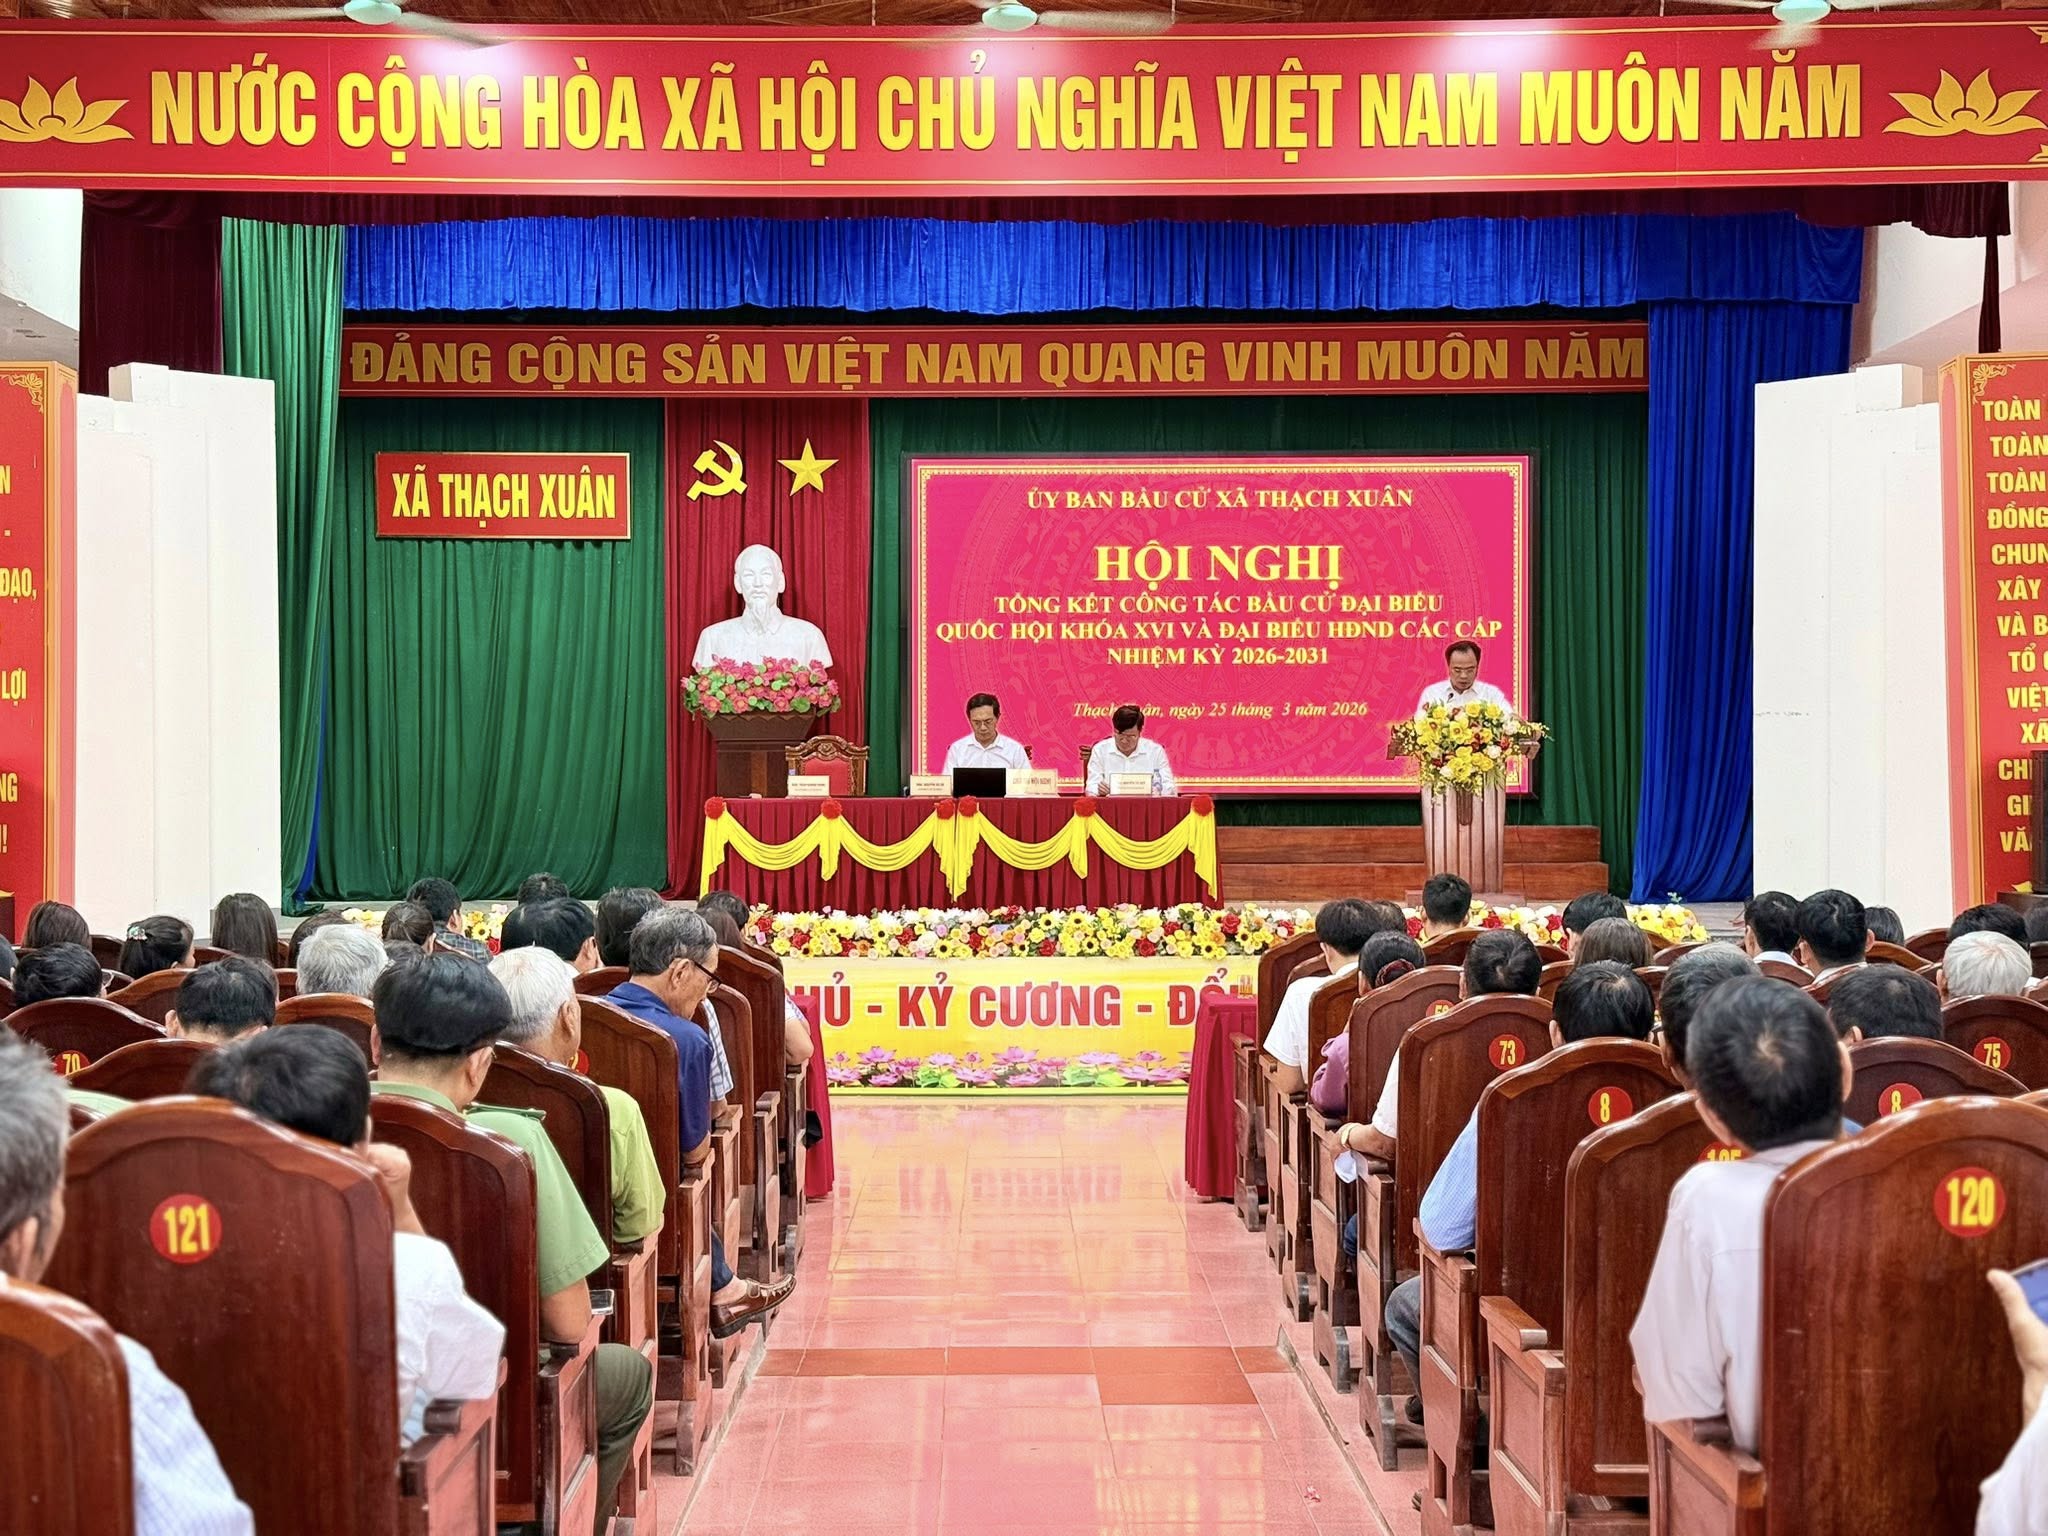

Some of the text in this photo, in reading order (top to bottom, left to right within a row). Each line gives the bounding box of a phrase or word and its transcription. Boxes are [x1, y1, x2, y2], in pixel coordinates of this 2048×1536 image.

[152, 48, 1861, 166] NƯỚC CỘNG HÒA XÃ HỘI CHỦ NGHĨA VIỆT NAM MUÔN NĂM
[350, 331, 1644, 390] ĐẢNG CỘNG SẢN VIỆT NAM QUANG VINH MUÔN NĂM
[1981, 395, 2041, 421] TOÀN
[1990, 431, 2048, 457] TOÀN
[1986, 466, 2046, 493] TOÀN
[392, 464, 616, 528] XÃ THẠCH XUÂN
[1027, 485, 1413, 512] ỦY BAN BẦU CỬ XÃ THẠCH XUÂN
[1987, 501, 2048, 529] ĐỒNG
[1093, 540, 1344, 591] HỘI NGHỊ
[1997, 575, 2041, 601] XÂY
[993, 590, 1443, 617] TỔNG KẾT CÔNG TÁC BẦU CỬ ĐẠI BIỂU
[936, 617, 1503, 644] QUỐC HỘI KHÓA XVI VÀ ĐẠI BIỂU HĐND CÁC CẤP
[1997, 610, 2027, 637] VÀ
[1107, 644, 1328, 669] NHIỆM KỲ 2026-2031
[2008, 642, 2037, 672] TỔ
[2, 667, 27, 706] LỢI
[1073, 702, 1120, 719] Thạch
[1169, 703, 1205, 720] ngày
[1208, 702, 1227, 717] 25
[1231, 702, 1274, 719] tháng
[1281, 702, 1291, 716] 3
[1295, 703, 1327, 717] năm
[1330, 702, 1368, 717] 2026
[2000, 826, 2033, 852] VĂ
[867, 1005, 882, 1013] -
[899, 972, 953, 1026] KỶ
[970, 981, 1120, 1027] CƯƠNG
[1137, 1004, 1152, 1012] -
[62, 1053, 81, 1076] 70
[1499, 1040, 1516, 1065] 73
[1983, 1043, 2001, 1069] 75
[1600, 1092, 1610, 1123] 8
[1891, 1090, 1902, 1114] 8
[1946, 1176, 1996, 1227] 120
[163, 1204, 211, 1254] 121
